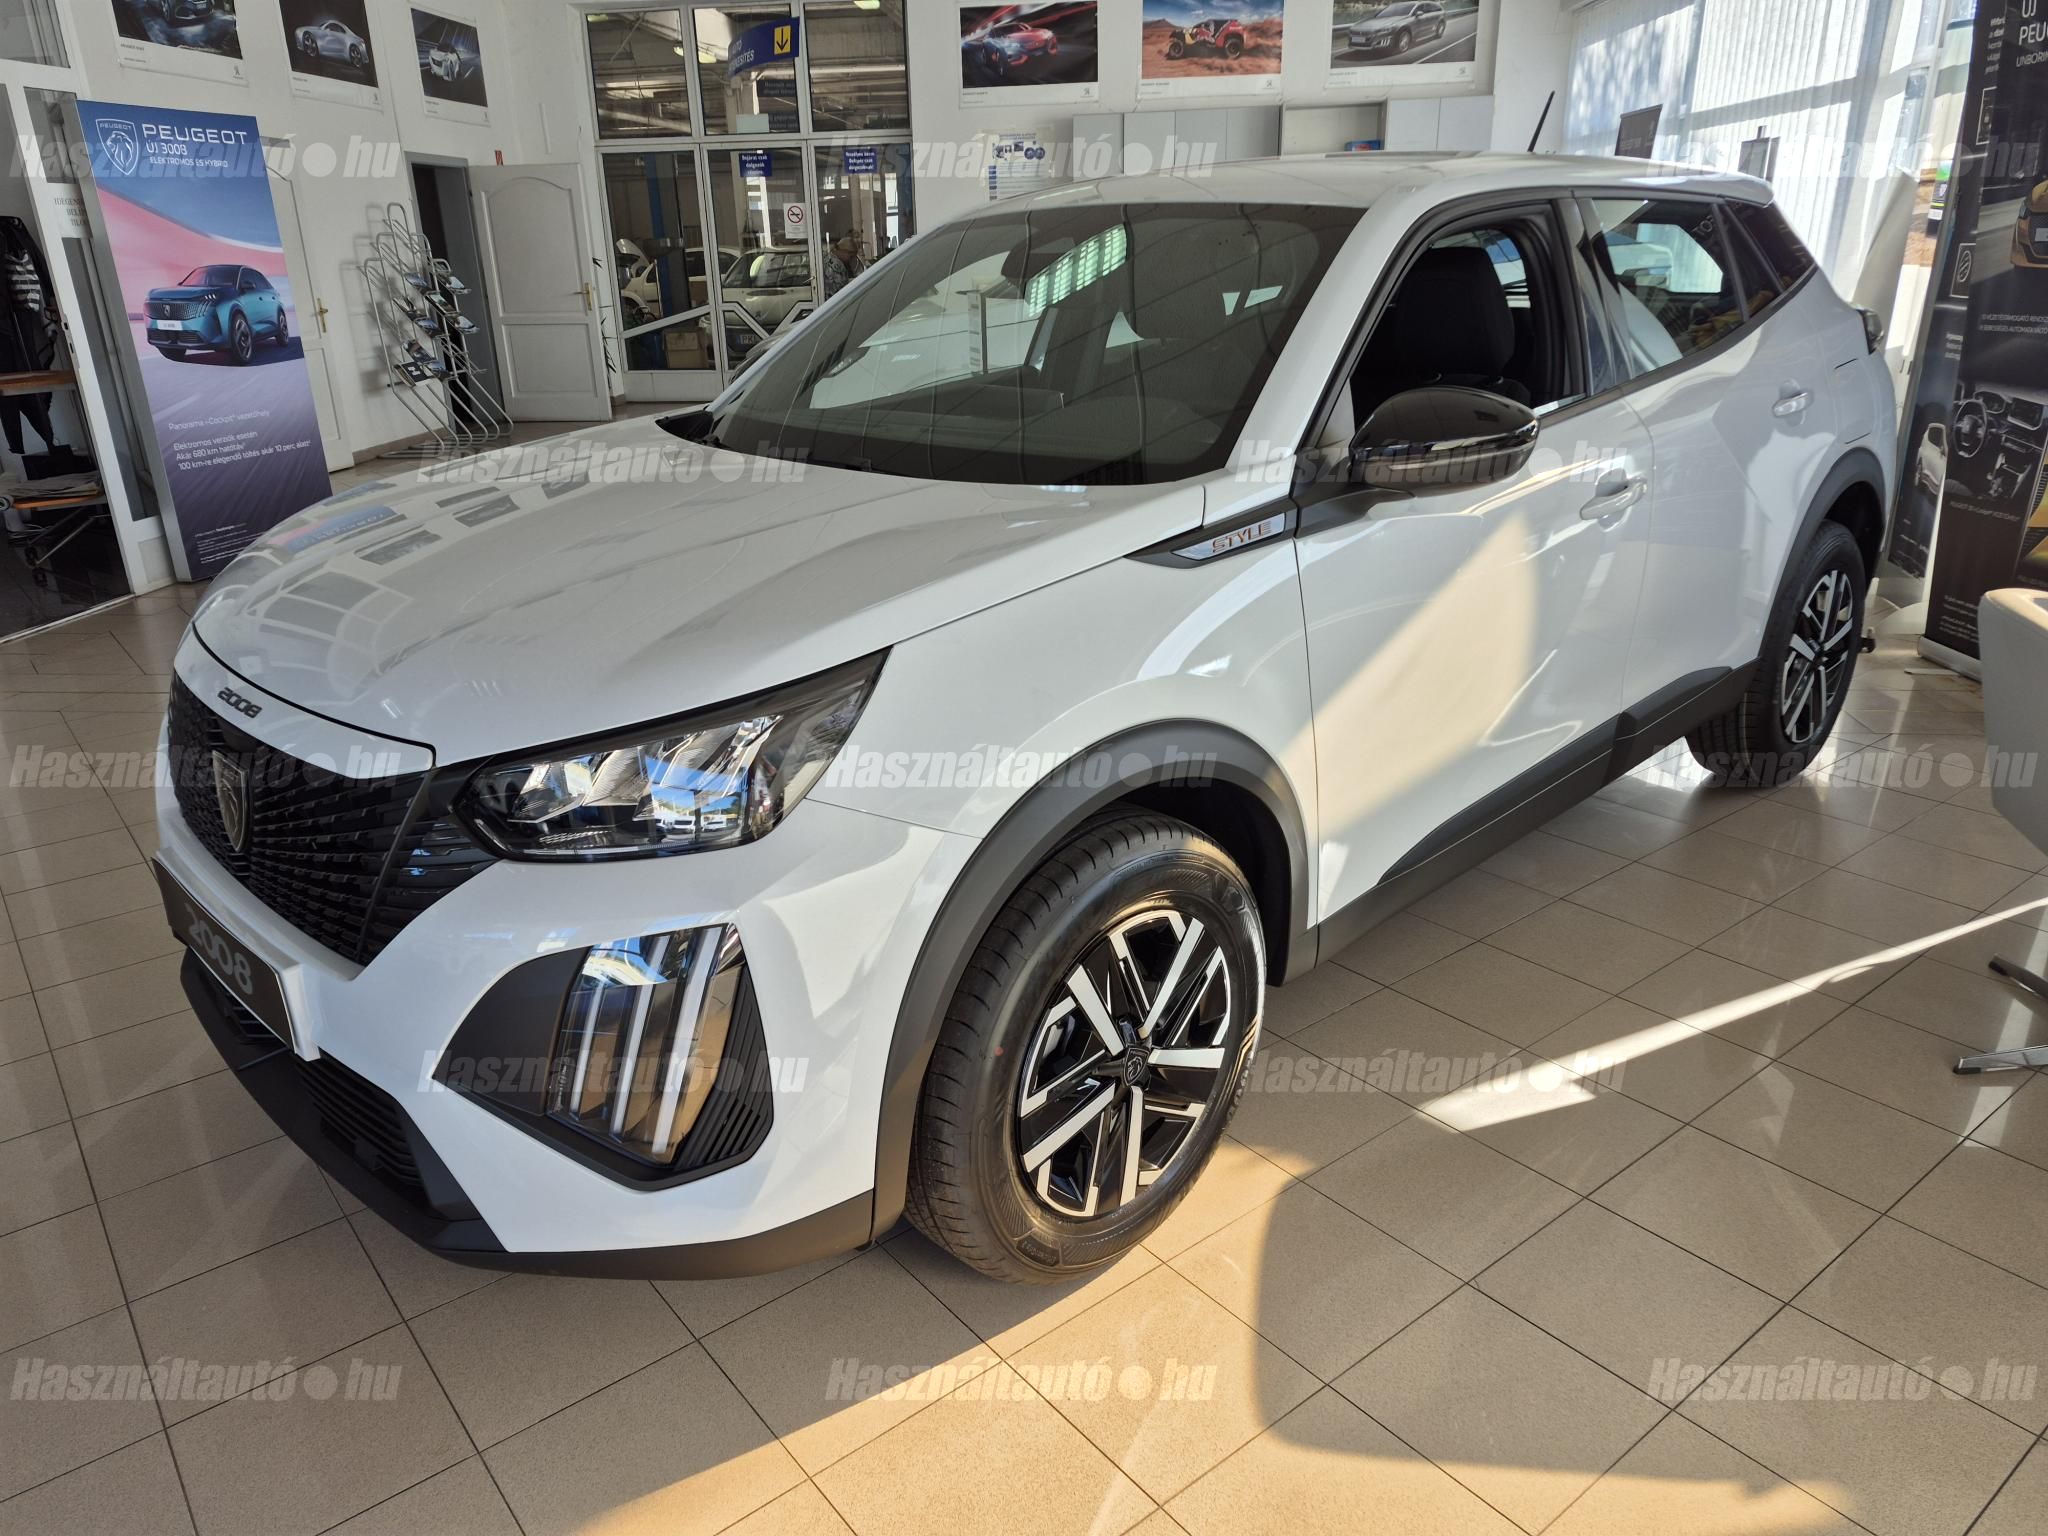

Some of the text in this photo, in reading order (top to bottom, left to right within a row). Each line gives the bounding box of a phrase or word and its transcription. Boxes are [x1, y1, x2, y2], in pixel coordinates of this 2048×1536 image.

[2019, 21, 2048, 46] PEU
[142, 123, 247, 144] PEUGEOT
[161, 142, 188, 155] 3008
[173, 440, 212, 451] Elektromos
[178, 461, 191, 471] 100
[1212, 520, 1272, 553] STYLE
[217, 686, 263, 719] 2008
[183, 899, 254, 995] 2008
